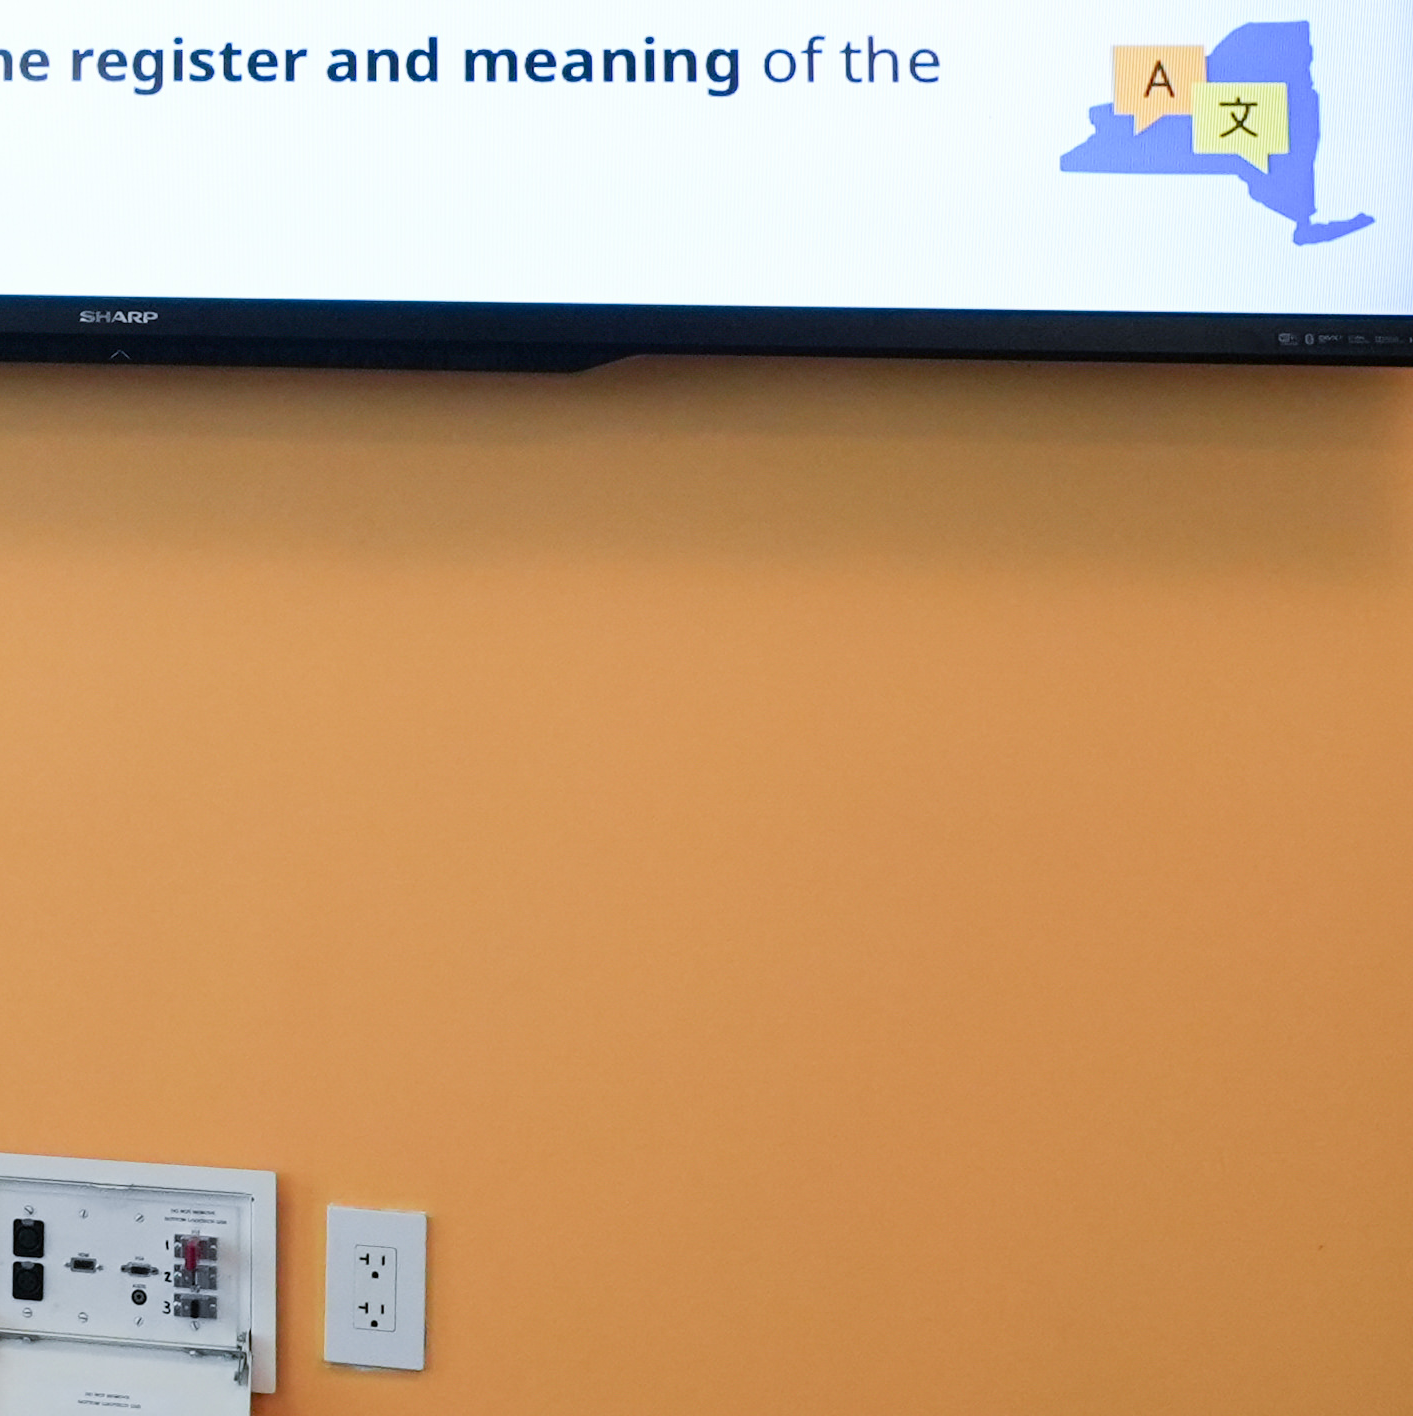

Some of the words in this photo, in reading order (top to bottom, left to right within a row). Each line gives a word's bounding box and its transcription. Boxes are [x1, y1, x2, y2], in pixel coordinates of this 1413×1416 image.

[71, 37, 308, 95] register
[327, 36, 438, 82] and
[464, 36, 740, 96] meaning
[763, 35, 825, 84] of
[840, 35, 941, 84] the
[1144, 60, 1176, 99] A
[1219, 97, 1259, 139] 文
[79, 310, 160, 325] SHARP
[165, 1240, 170, 1251] 1
[164, 1272, 173, 1283] 2
[163, 1301, 172, 1315] 3
